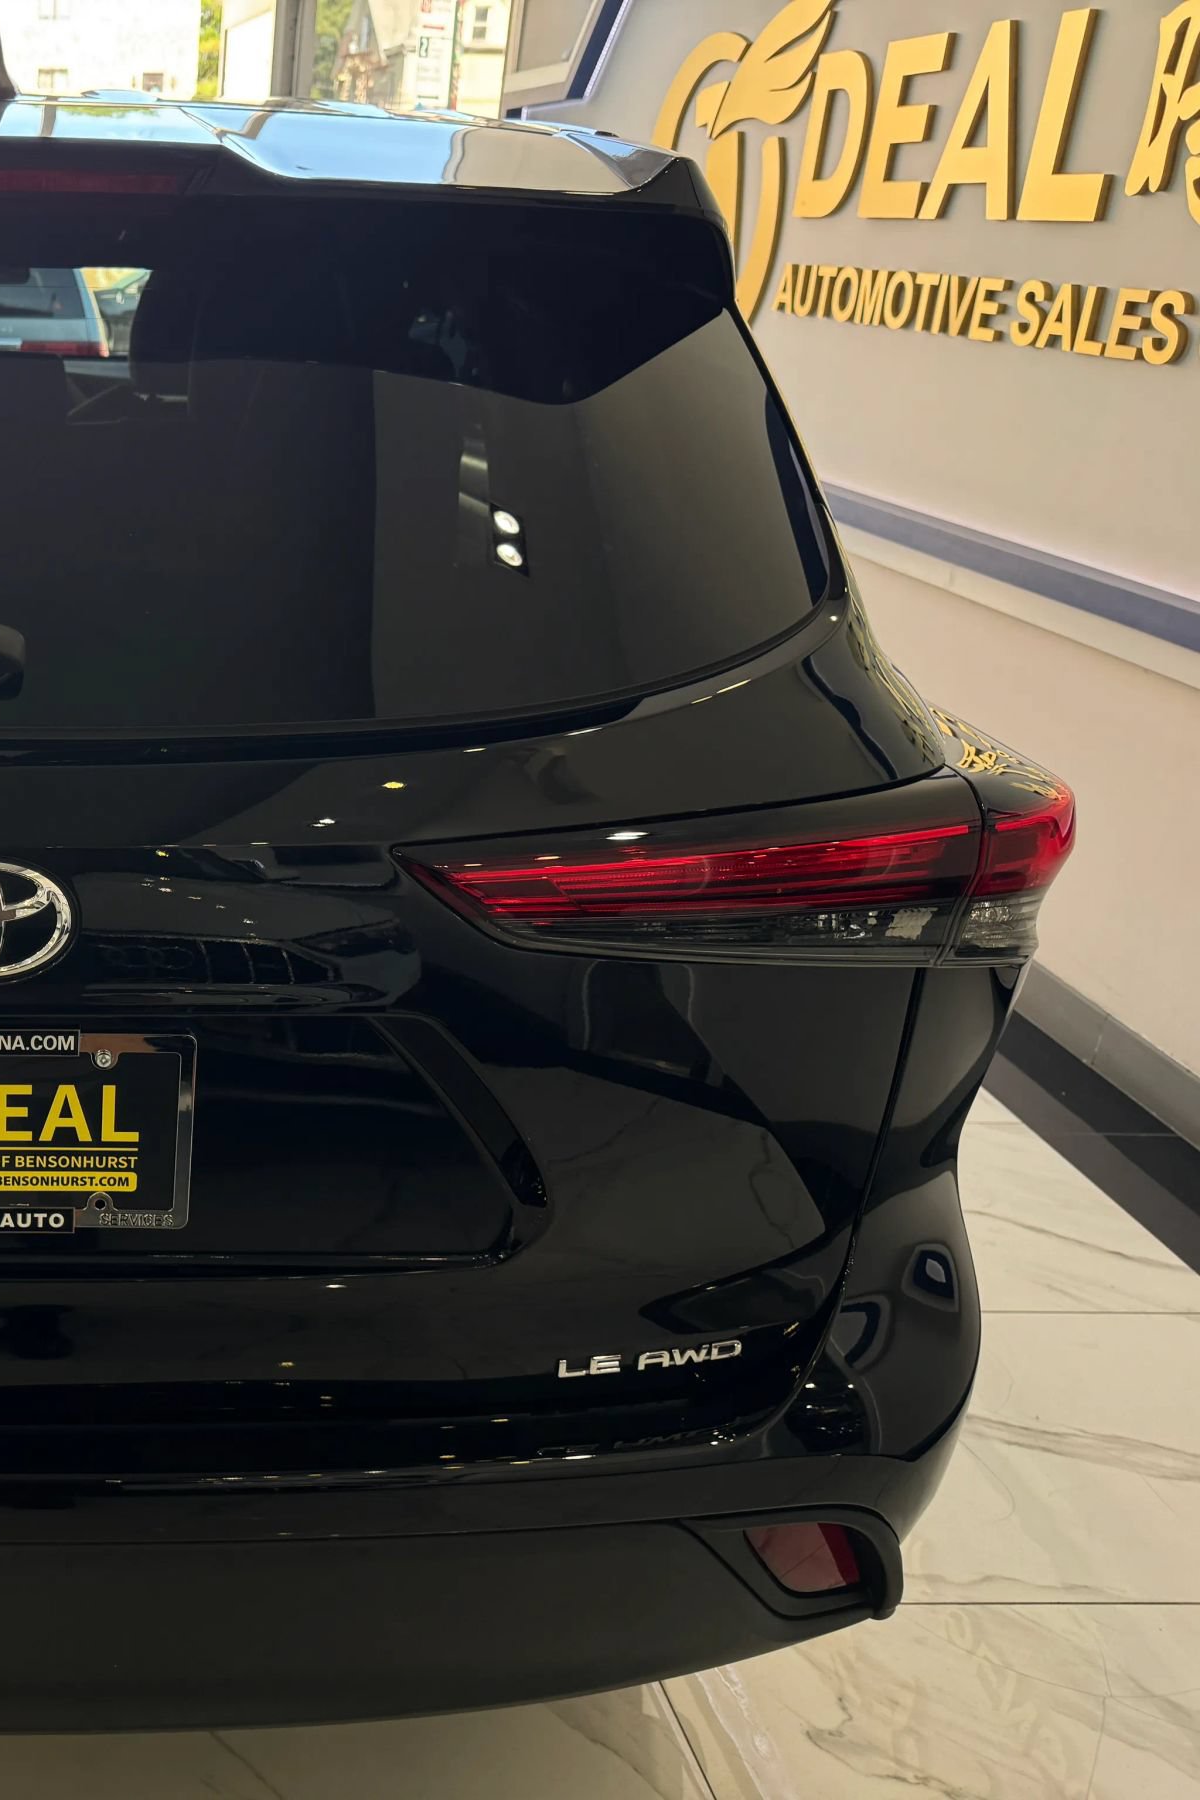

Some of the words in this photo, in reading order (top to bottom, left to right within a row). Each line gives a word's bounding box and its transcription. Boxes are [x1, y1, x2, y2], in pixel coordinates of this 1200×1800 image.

[771, 262, 1008, 342] AUTOMOTIVE
[1009, 279, 1193, 365] SALES
[14, 1154, 138, 1170] BENSONHURST
[0, 1212, 66, 1229] AUTO
[99, 1213, 174, 1227] SERVICES
[557, 1354, 622, 1379] LE
[637, 1339, 743, 1371] AWD
